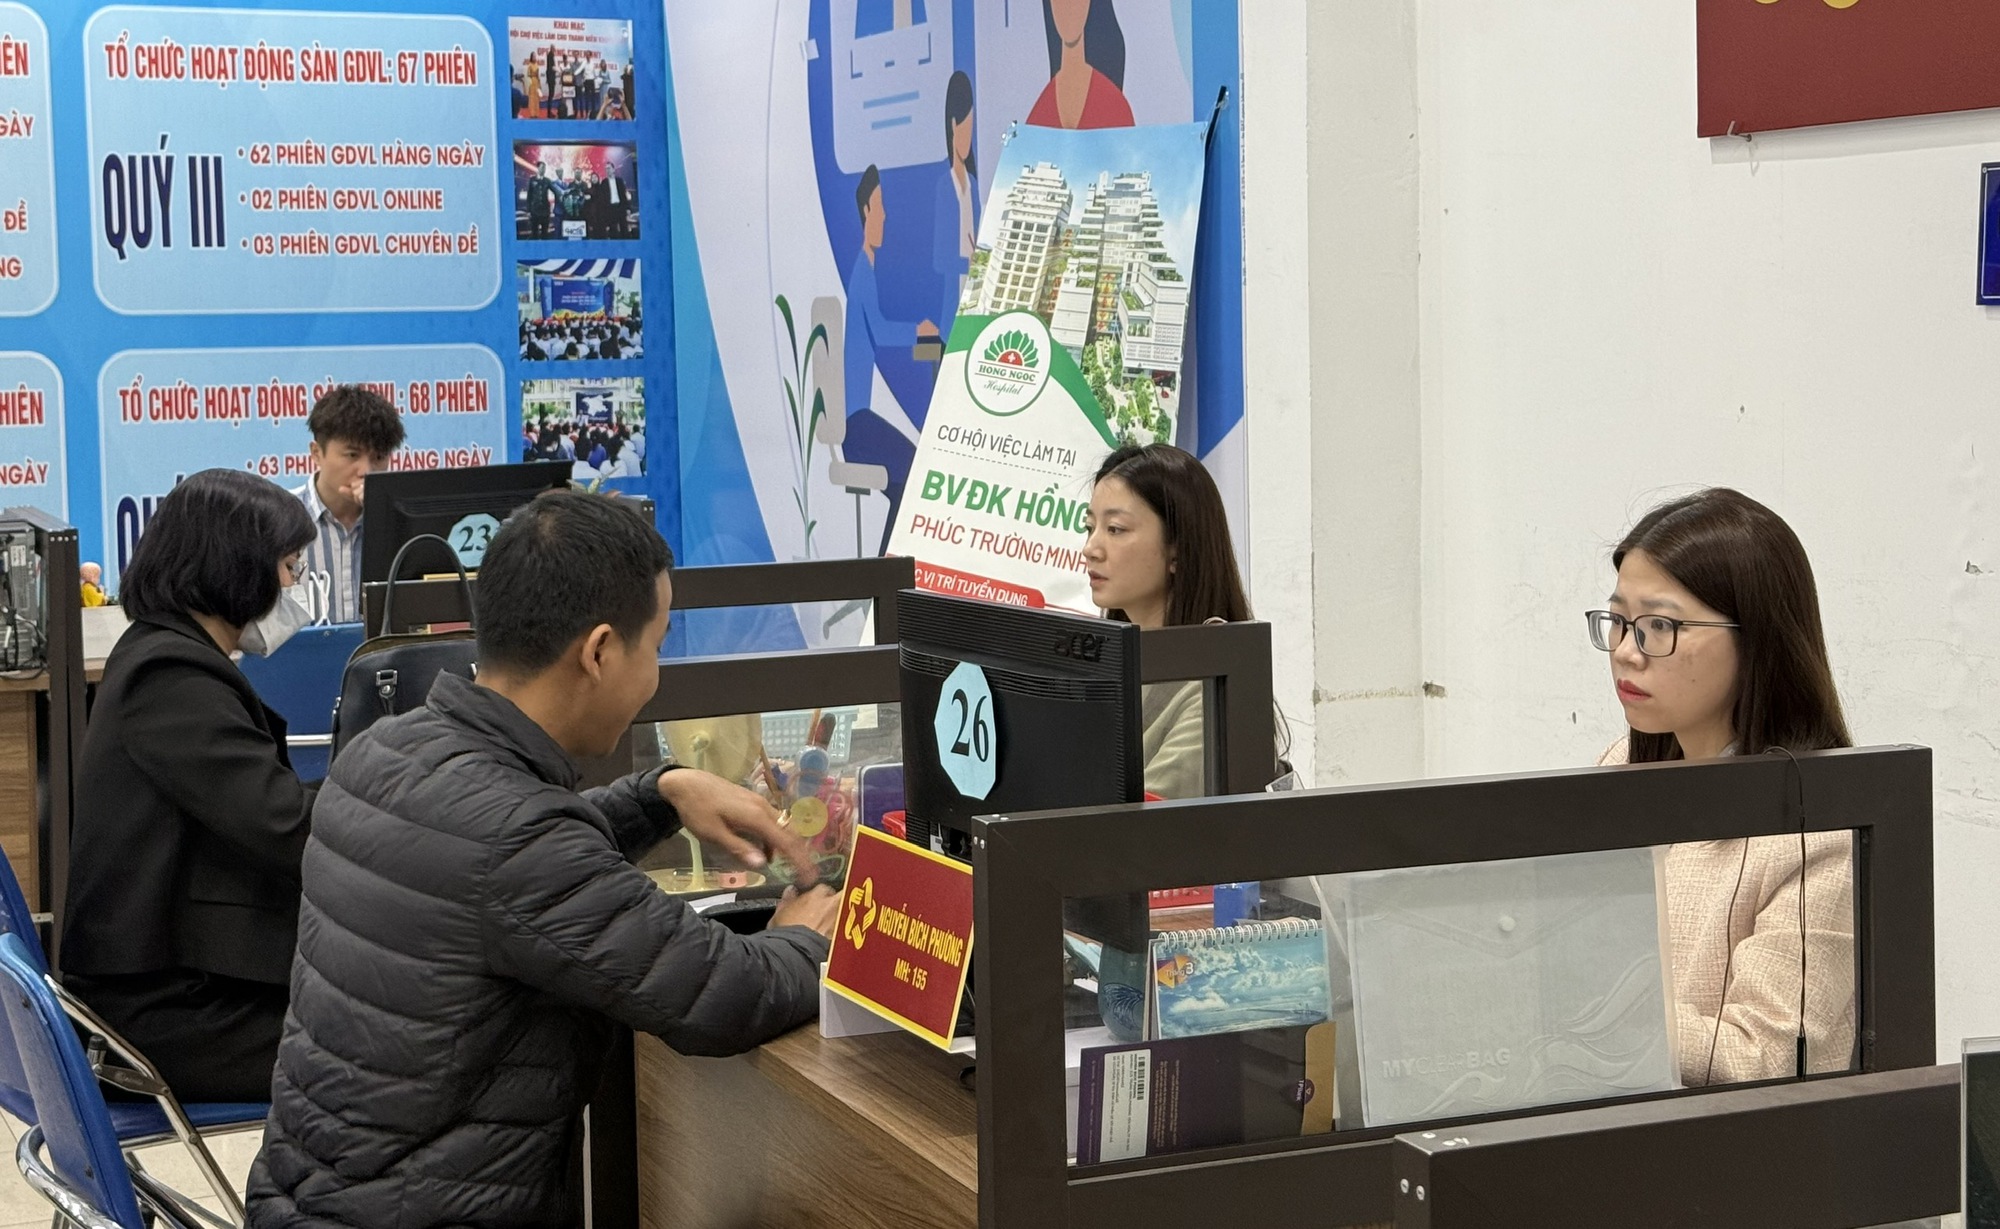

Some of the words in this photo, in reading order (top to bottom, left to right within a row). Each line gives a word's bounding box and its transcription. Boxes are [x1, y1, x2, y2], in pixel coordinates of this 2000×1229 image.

[105, 31, 128, 78] TỔ
[135, 39, 185, 79] CHỨC
[191, 47, 238, 88] HOẠT
[244, 41, 295, 88] ĐỘNG
[301, 42, 338, 82] SÀN
[344, 50, 393, 83] GDVL:
[398, 52, 418, 84] 67
[424, 46, 477, 85] PHIÊN
[250, 144, 271, 164] 62
[276, 139, 325, 164] PHIÊN
[331, 145, 377, 165] GDVL
[382, 140, 432, 165] HÀNG
[437, 140, 484, 166] NGÀY
[102, 134, 175, 260] QUÝ
[188, 156, 225, 248] III
[252, 189, 272, 209] 02
[278, 184, 327, 209] PHIÊN
[333, 190, 378, 209] GDVL
[383, 190, 442, 209] ONLINE
[4, 200, 27, 230] ĐỀ
[254, 235, 274, 254] 03
[280, 229, 329, 254] PHIÊN
[335, 235, 380, 254] GDVL
[385, 229, 452, 254] CHUYÊN
[458, 224, 478, 254] ĐỀ
[979, 364, 1007, 377] HONG
[1009, 370, 1036, 382] NGOC
[984, 380, 1024, 396] Hospital
[119, 375, 143, 422] TỔ
[149, 380, 198, 421] CHỨC
[205, 386, 251, 426] HOẠT
[257, 378, 307, 425] ĐỘNG
[409, 381, 430, 413] 68
[436, 374, 488, 413] PHIÊN
[258, 456, 279, 475] 63
[390, 446, 439, 471] HÀNG
[445, 444, 492, 467] NGÀY
[937, 425, 962, 442] CƠ
[960, 428, 987, 451] HỘI
[990, 434, 1022, 458] VIỆC
[1023, 440, 1053, 462] LÀM
[1057, 447, 1076, 469] TẠI
[921, 469, 1012, 517] BVĐK
[1014, 483, 1090, 534] HỒNG
[459, 524, 491, 552] 23
[910, 514, 965, 545] PHÚC
[970, 528, 1043, 563] TRƯỜNG
[1044, 545, 1088, 574] MINH
[924, 570, 936, 588] VỊ
[937, 573, 958, 591] TRÍ
[957, 579, 997, 600] TUYỂN
[950, 688, 989, 763] 26
[907, 913, 930, 952] BÍCH
[894, 958, 912, 983] MH:
[911, 966, 928, 991] 155
[1185, 962, 1194, 975] 3
